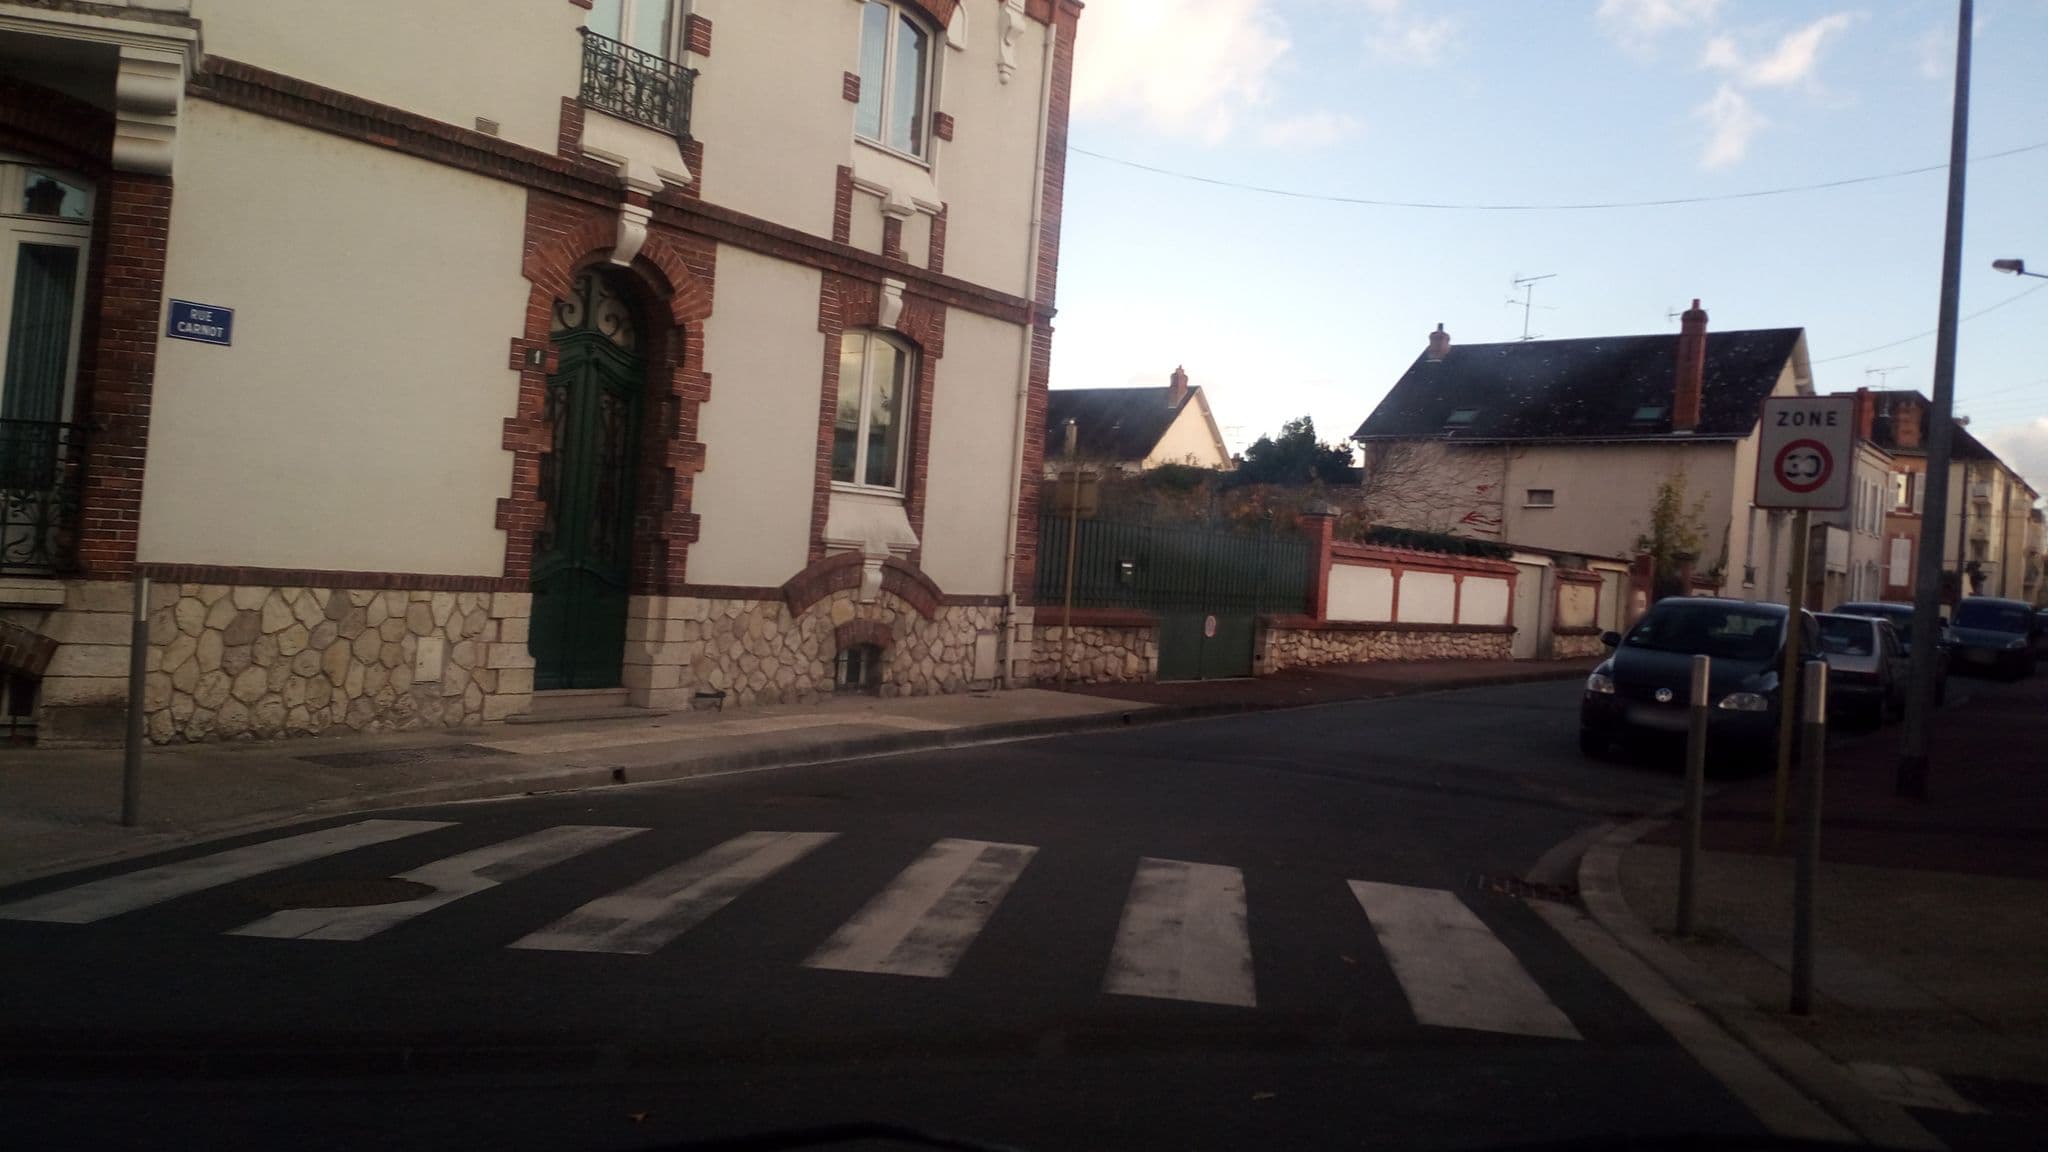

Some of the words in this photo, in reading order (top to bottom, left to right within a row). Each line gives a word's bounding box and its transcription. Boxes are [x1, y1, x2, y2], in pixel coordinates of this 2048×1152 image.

[191, 309, 213, 322] RUE
[177, 321, 224, 338] CARNOT
[534, 350, 541, 364] 1
[1777, 411, 1837, 426] ZONE
[1785, 455, 1822, 478] 30
